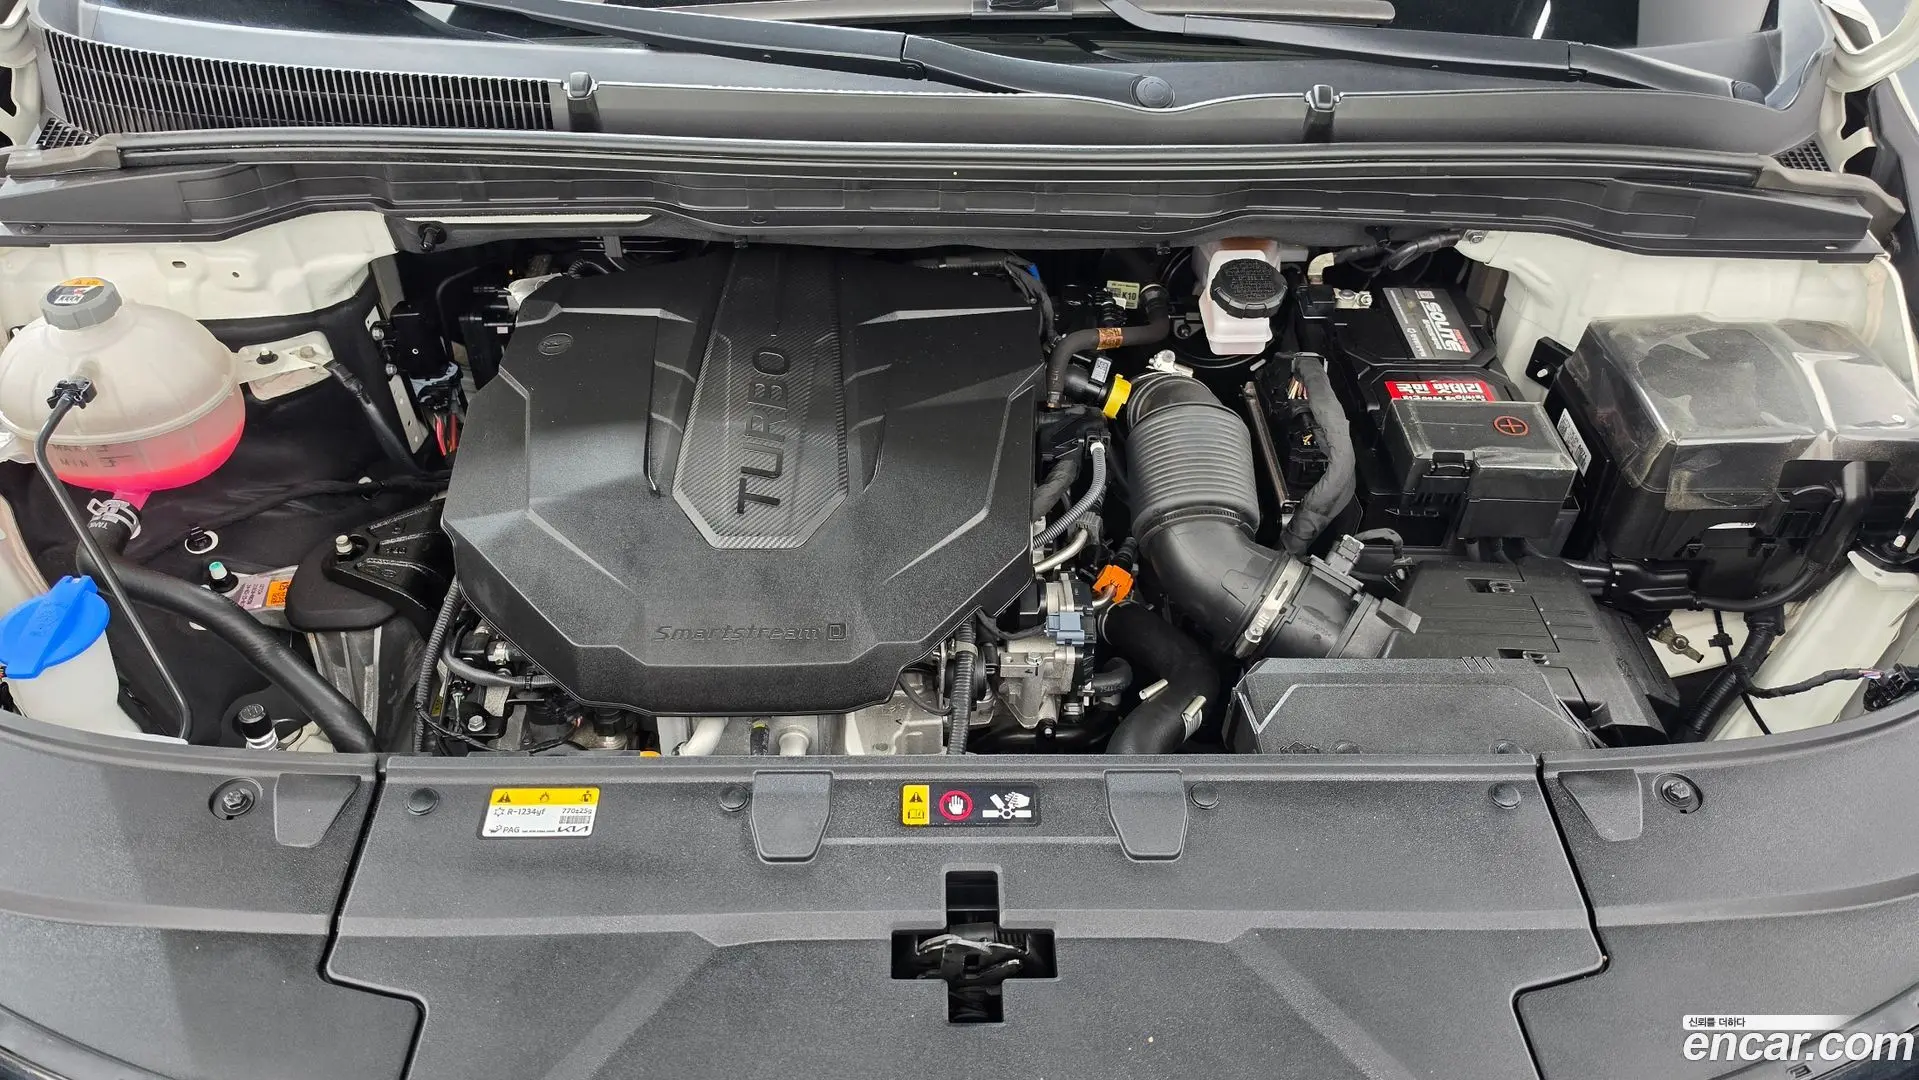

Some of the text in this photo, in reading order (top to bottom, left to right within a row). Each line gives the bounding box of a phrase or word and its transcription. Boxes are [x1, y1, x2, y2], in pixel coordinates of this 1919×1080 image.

[1396, 383, 1430, 394] 국민
[737, 348, 790, 515] TURBO
[655, 625, 820, 642] Smartstream
[507, 807, 546, 816] R-1234yf
[502, 826, 520, 834] PAG
[557, 825, 589, 833] KIA
